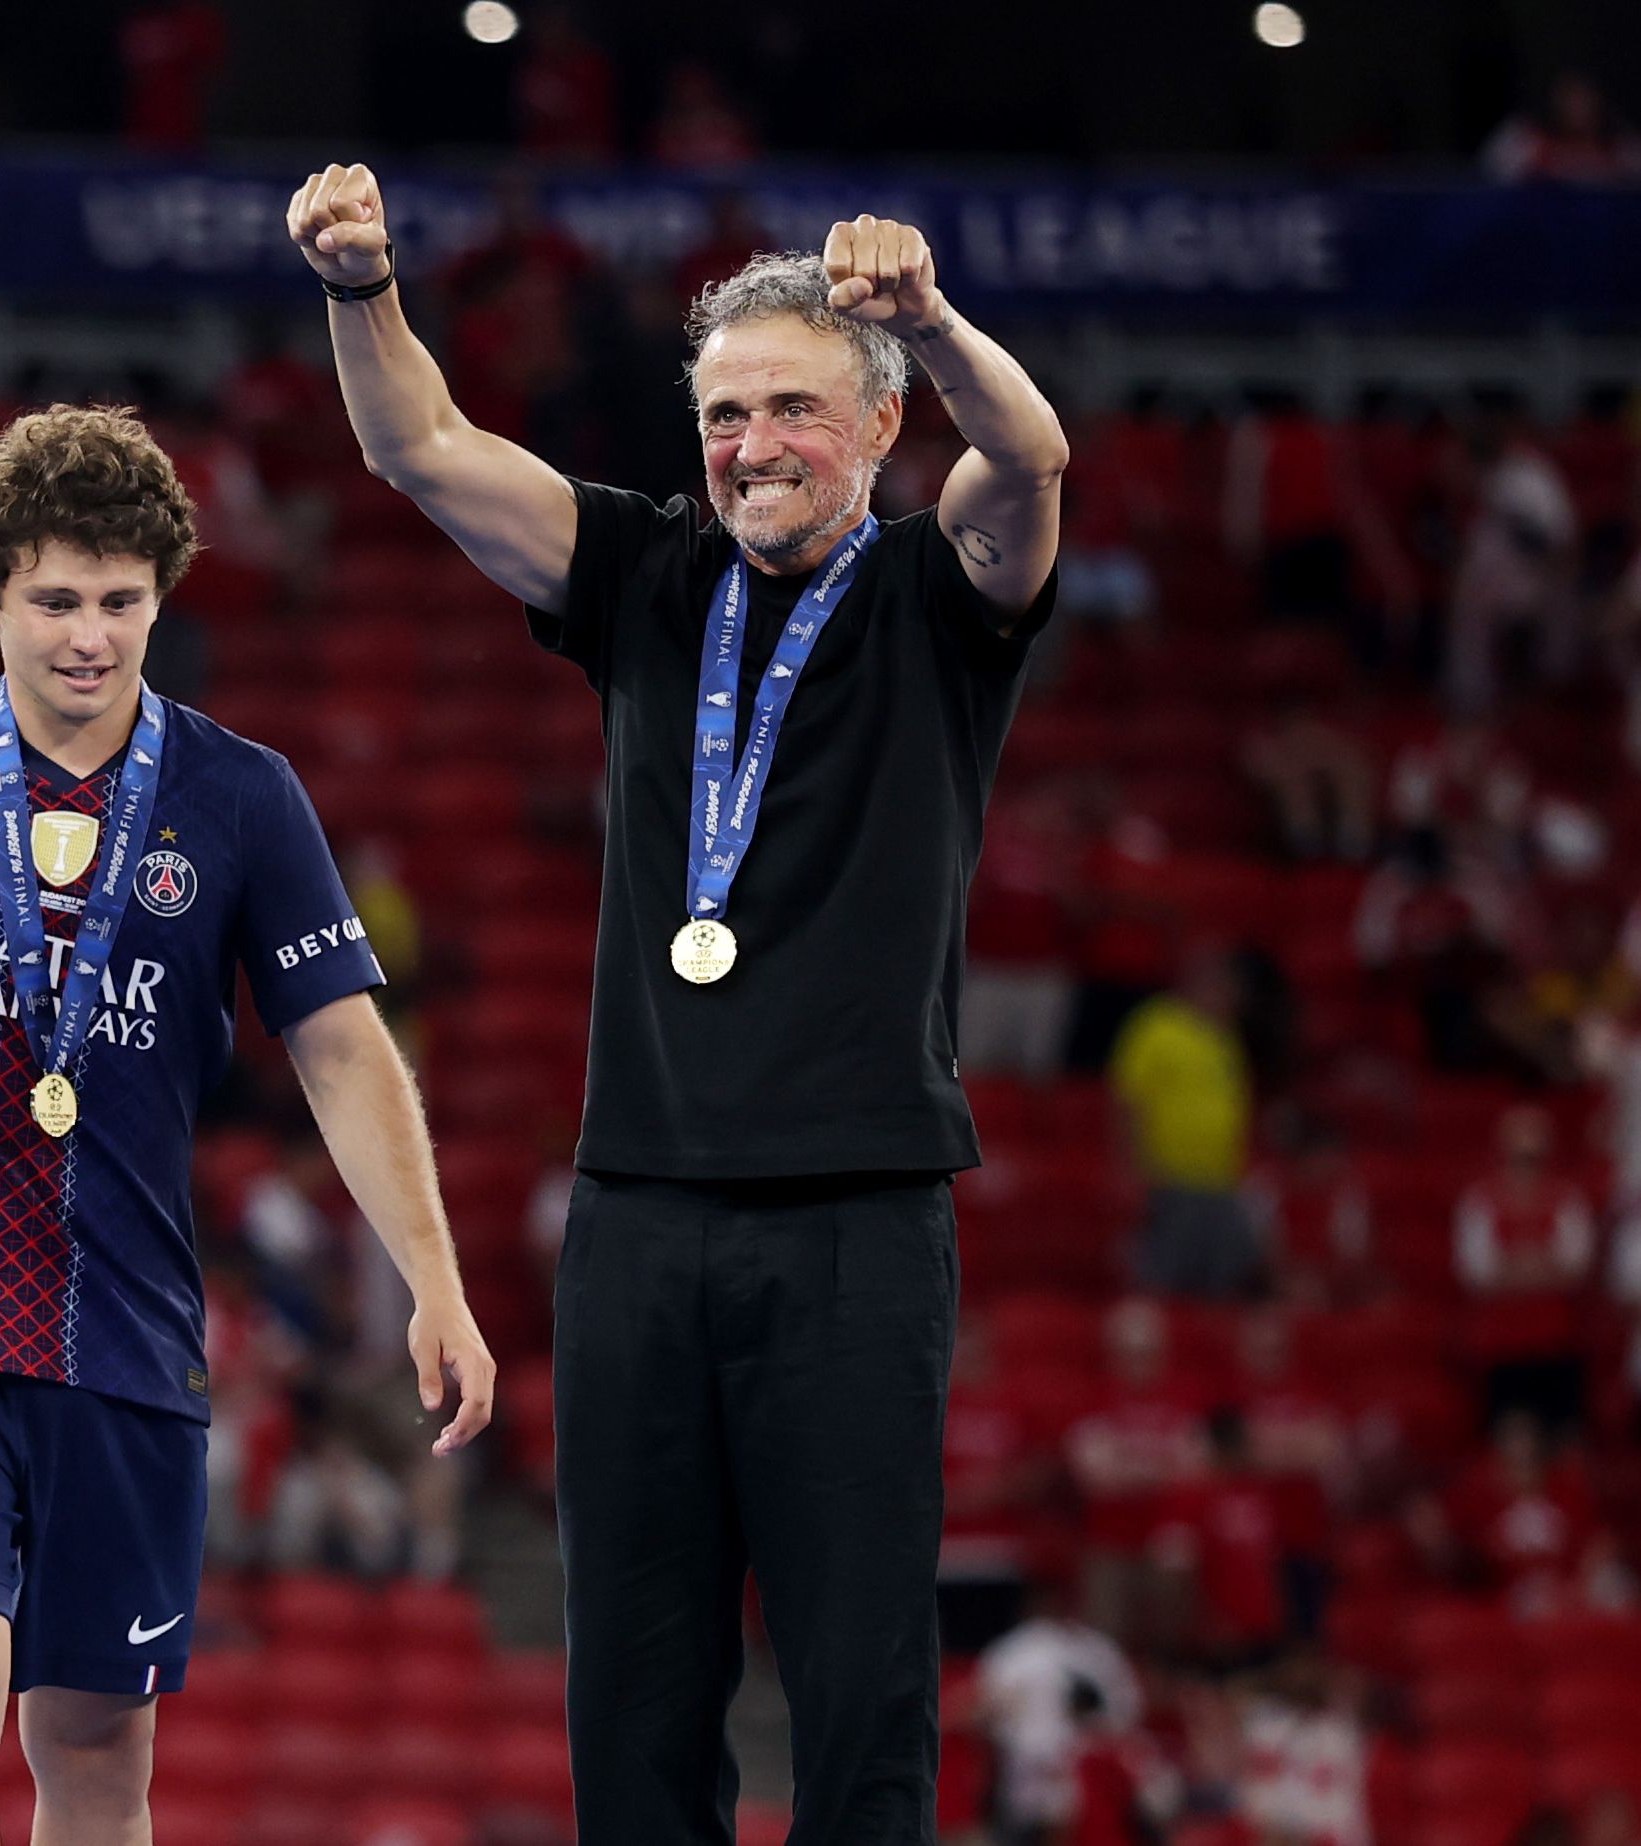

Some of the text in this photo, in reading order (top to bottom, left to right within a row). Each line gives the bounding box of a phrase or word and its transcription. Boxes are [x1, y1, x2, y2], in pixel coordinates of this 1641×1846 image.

[957, 192, 1347, 288] LEAGUE
[717, 620, 735, 666] FINAL
[730, 703, 774, 831] BUDAPEST 26 FINAL
[120, 785, 142, 829] FINAL
[145, 854, 188, 873] PARIS
[13, 876, 31, 927] FINAL
[40, 889, 75, 904] BUDAPEST
[61, 1000, 81, 1048] FINAL
